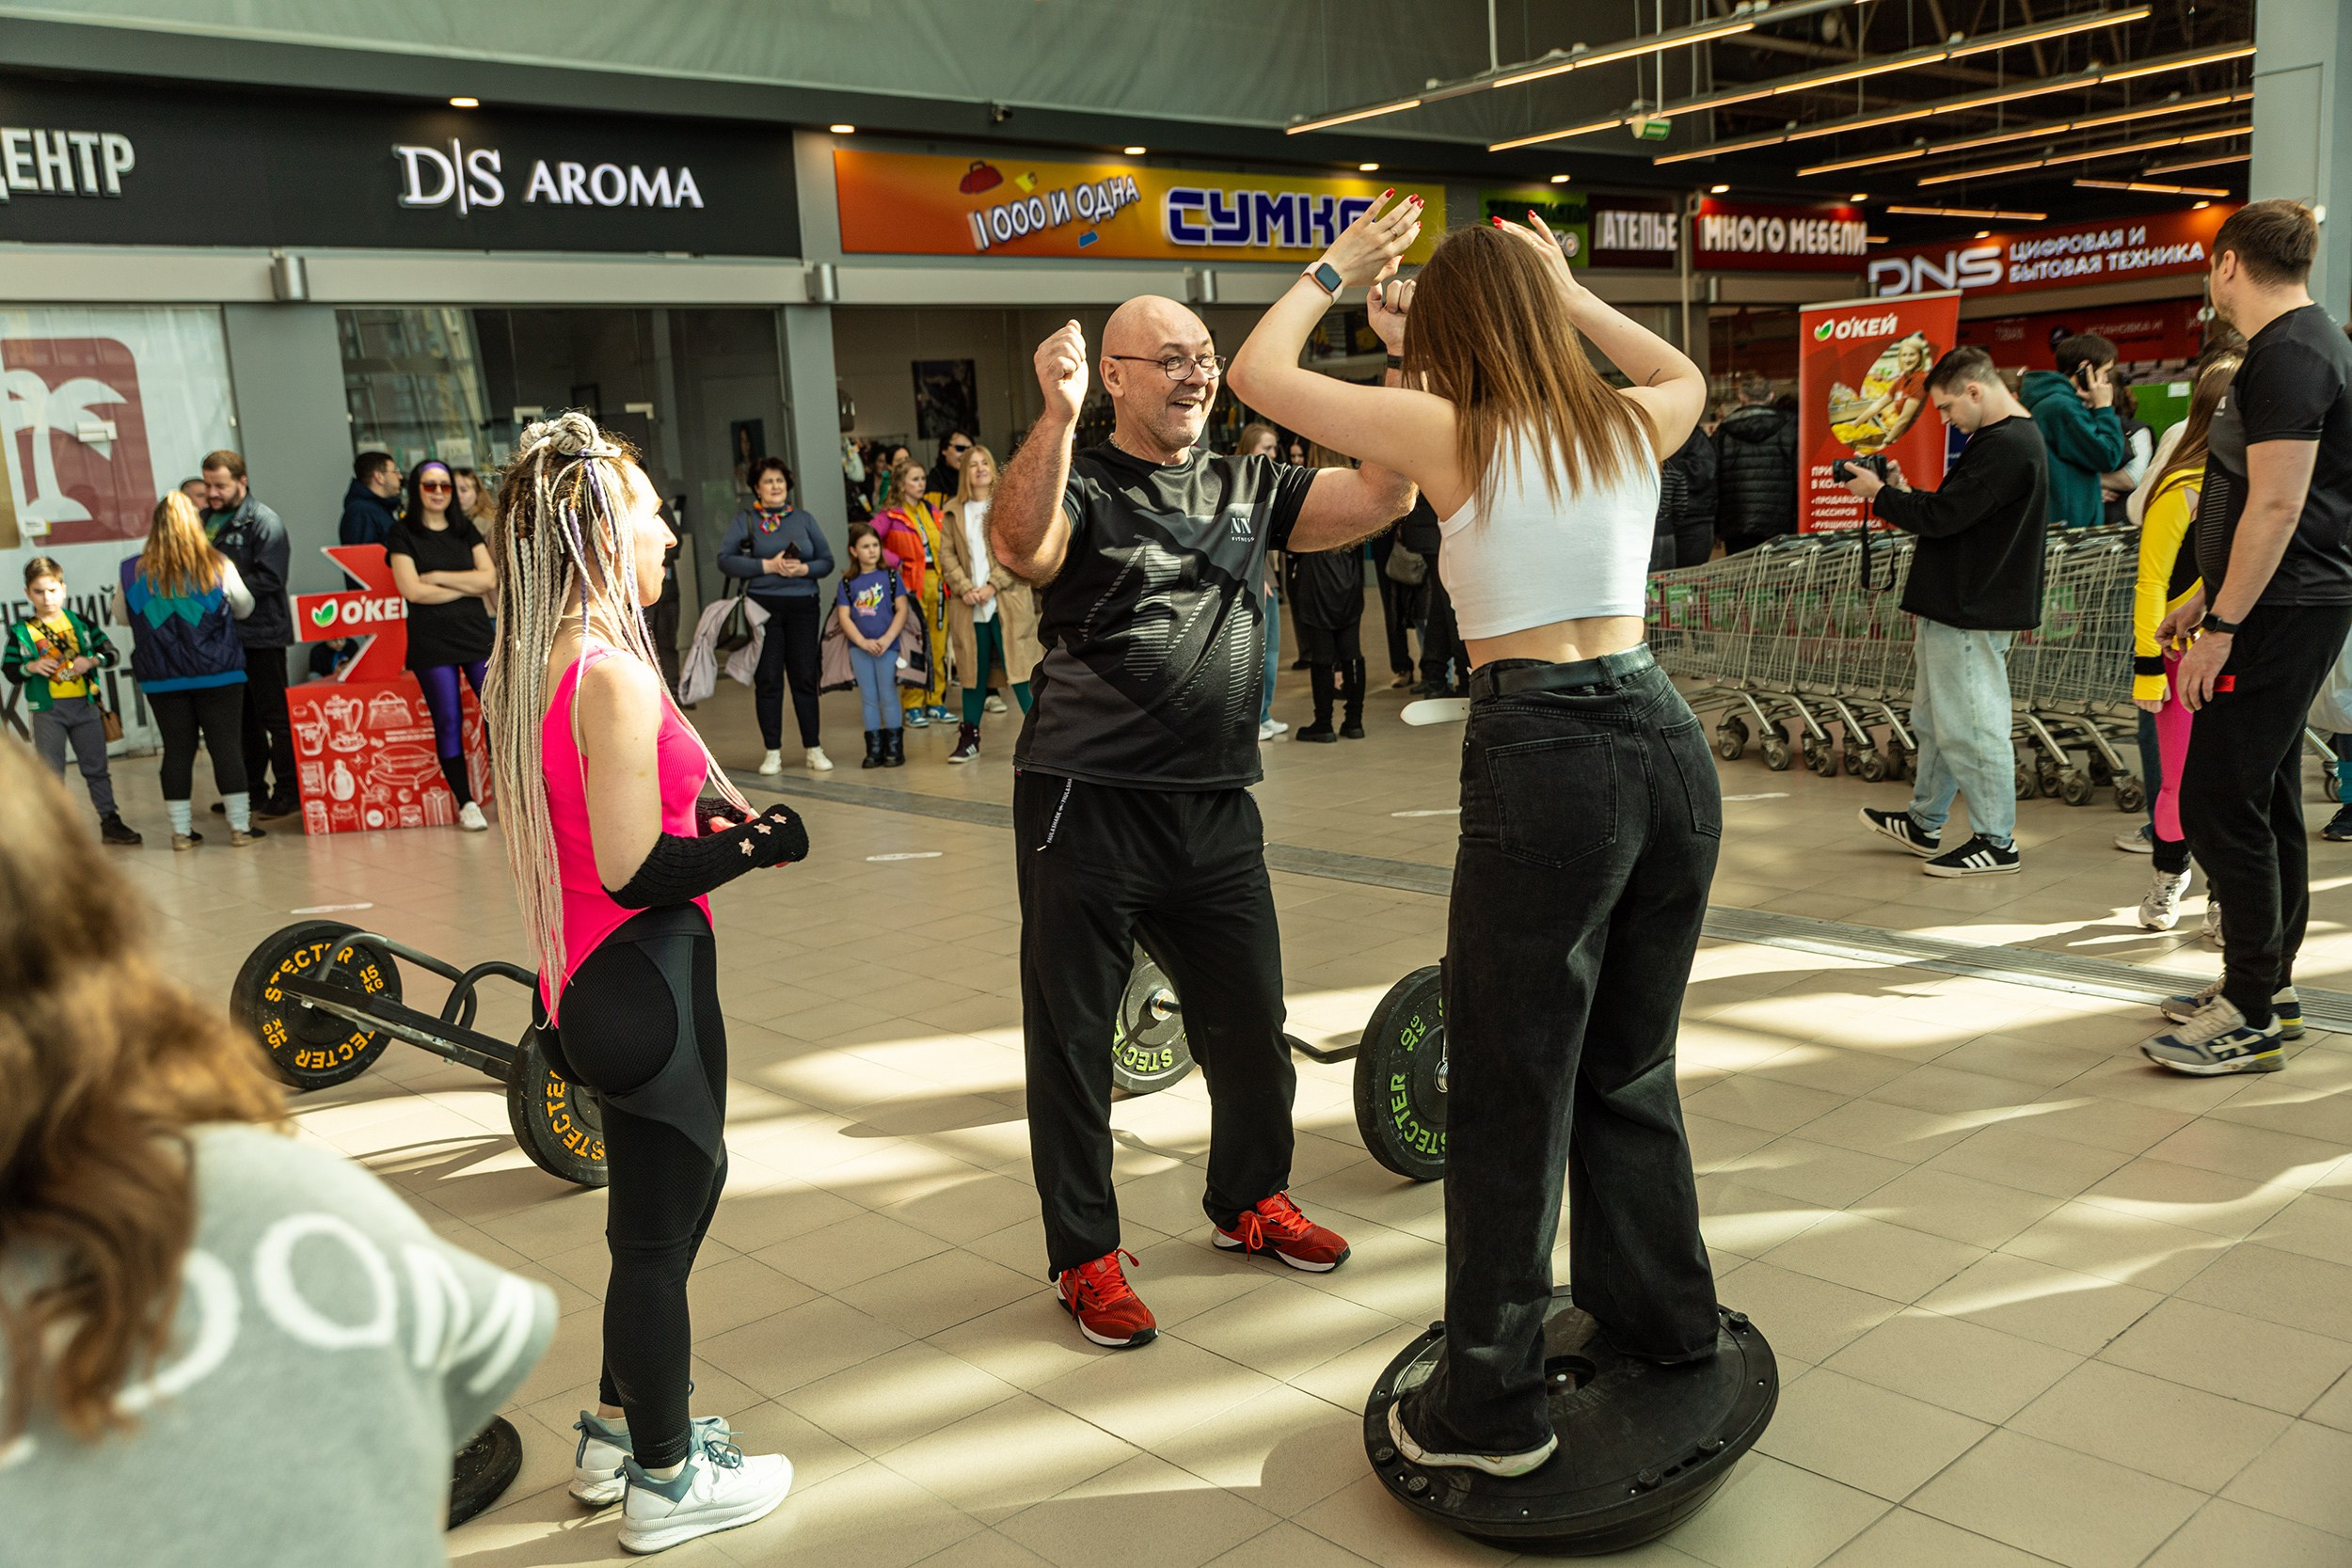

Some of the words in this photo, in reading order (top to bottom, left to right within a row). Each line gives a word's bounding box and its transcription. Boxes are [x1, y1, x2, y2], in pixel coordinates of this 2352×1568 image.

[0, 127, 135, 199] ЕНТР
[524, 159, 705, 208] AROMA
[1050, 189, 1072, 227] И
[1075, 175, 1141, 224] ОДНА
[1597, 210, 1678, 251] АТЕЛЬЕ
[1702, 214, 1787, 253] МНОГО
[1789, 217, 1868, 256] МЕБЕЛИ
[2009, 228, 2124, 262] ЦИФРОВАЯ
[2128, 225, 2147, 246] И
[1867, 245, 2004, 297] DNS
[2009, 254, 2103, 283] БЫТОВАЯ
[2106, 241, 2206, 272] ТЕХНИКА
[264, 942, 354, 1003] STECTR
[358, 964, 379, 985] 15
[365, 979, 384, 994] KG
[1400, 1027, 1419, 1052] 10
[1410, 1015, 1427, 1037] KG
[294, 1030, 376, 1069] ECTER
[546, 1069, 606, 1161] STECTE
